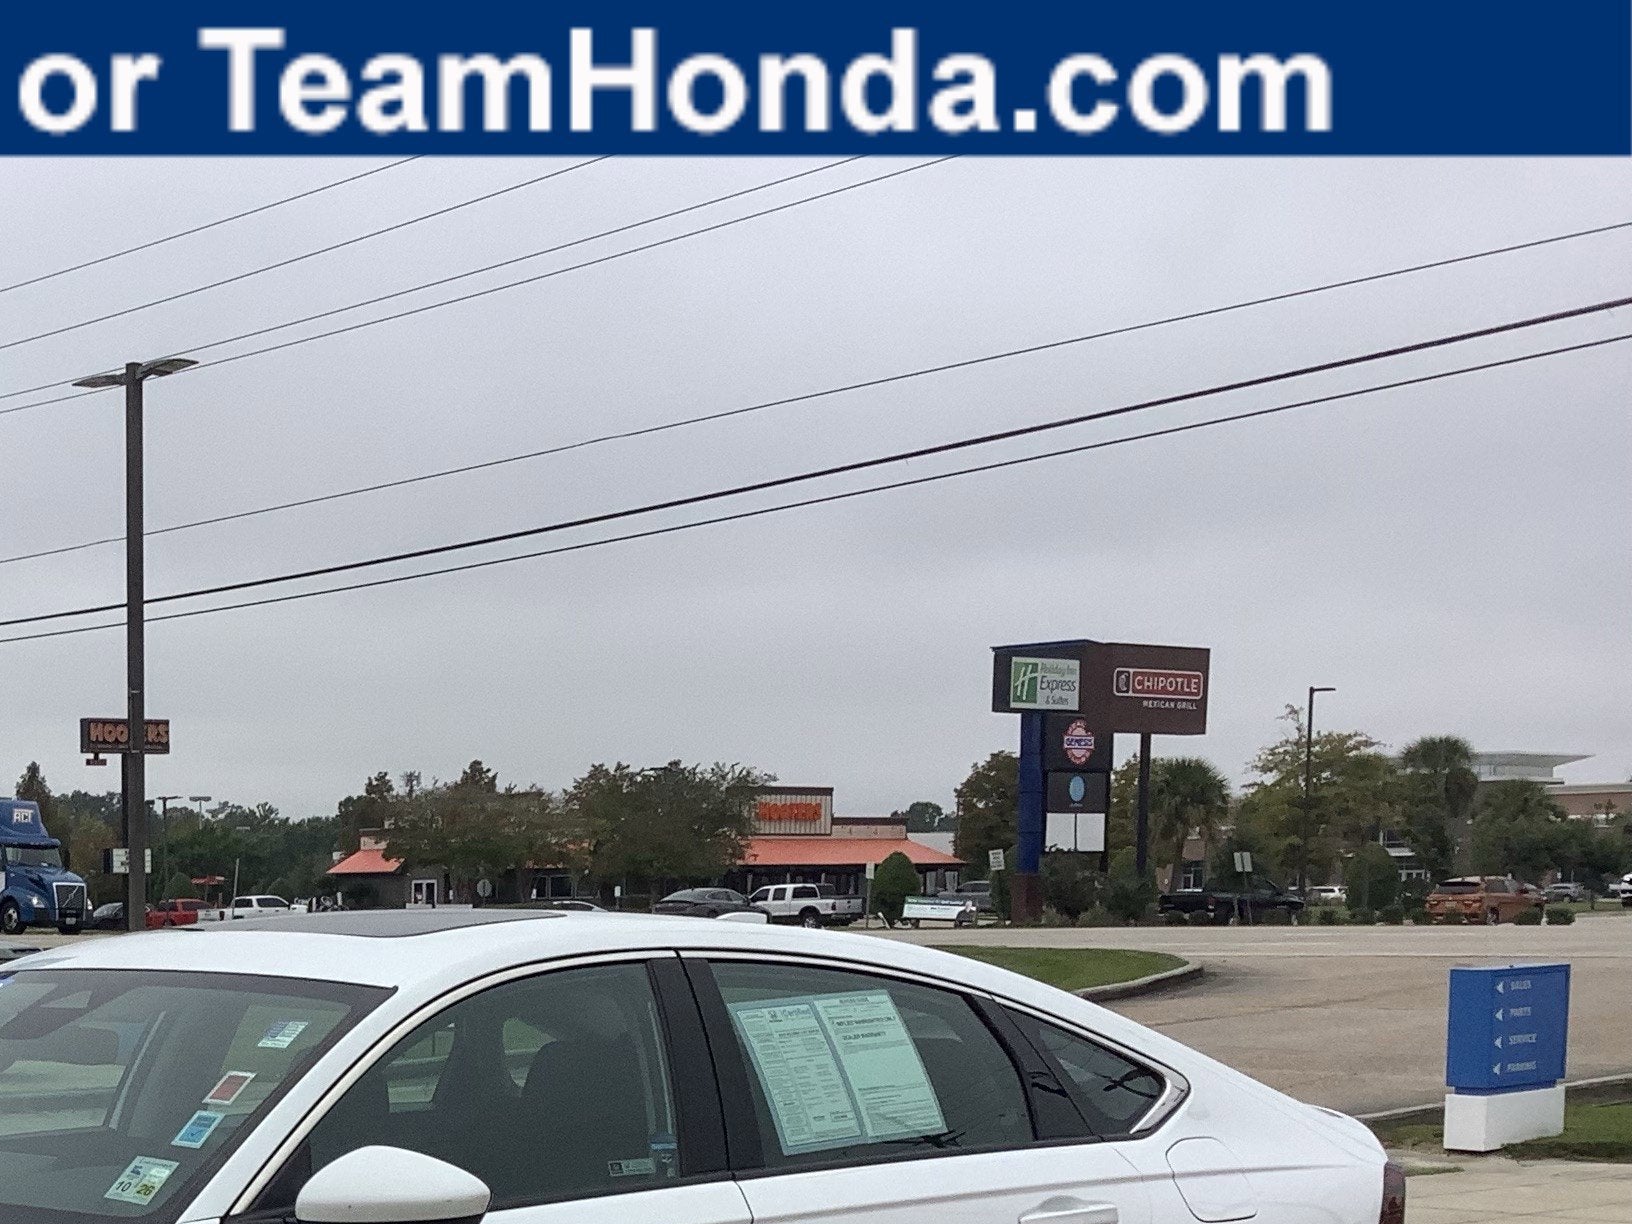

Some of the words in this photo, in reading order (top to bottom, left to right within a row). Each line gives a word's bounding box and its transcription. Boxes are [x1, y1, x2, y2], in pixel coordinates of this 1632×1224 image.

[1039, 675, 1077, 693] Express
[1134, 675, 1199, 693] CHIPOTLE
[1142, 700, 1175, 709] MEXICAN
[1176, 701, 1197, 710] GRILL
[115, 1180, 132, 1193] 10
[136, 1184, 156, 1197] 26
